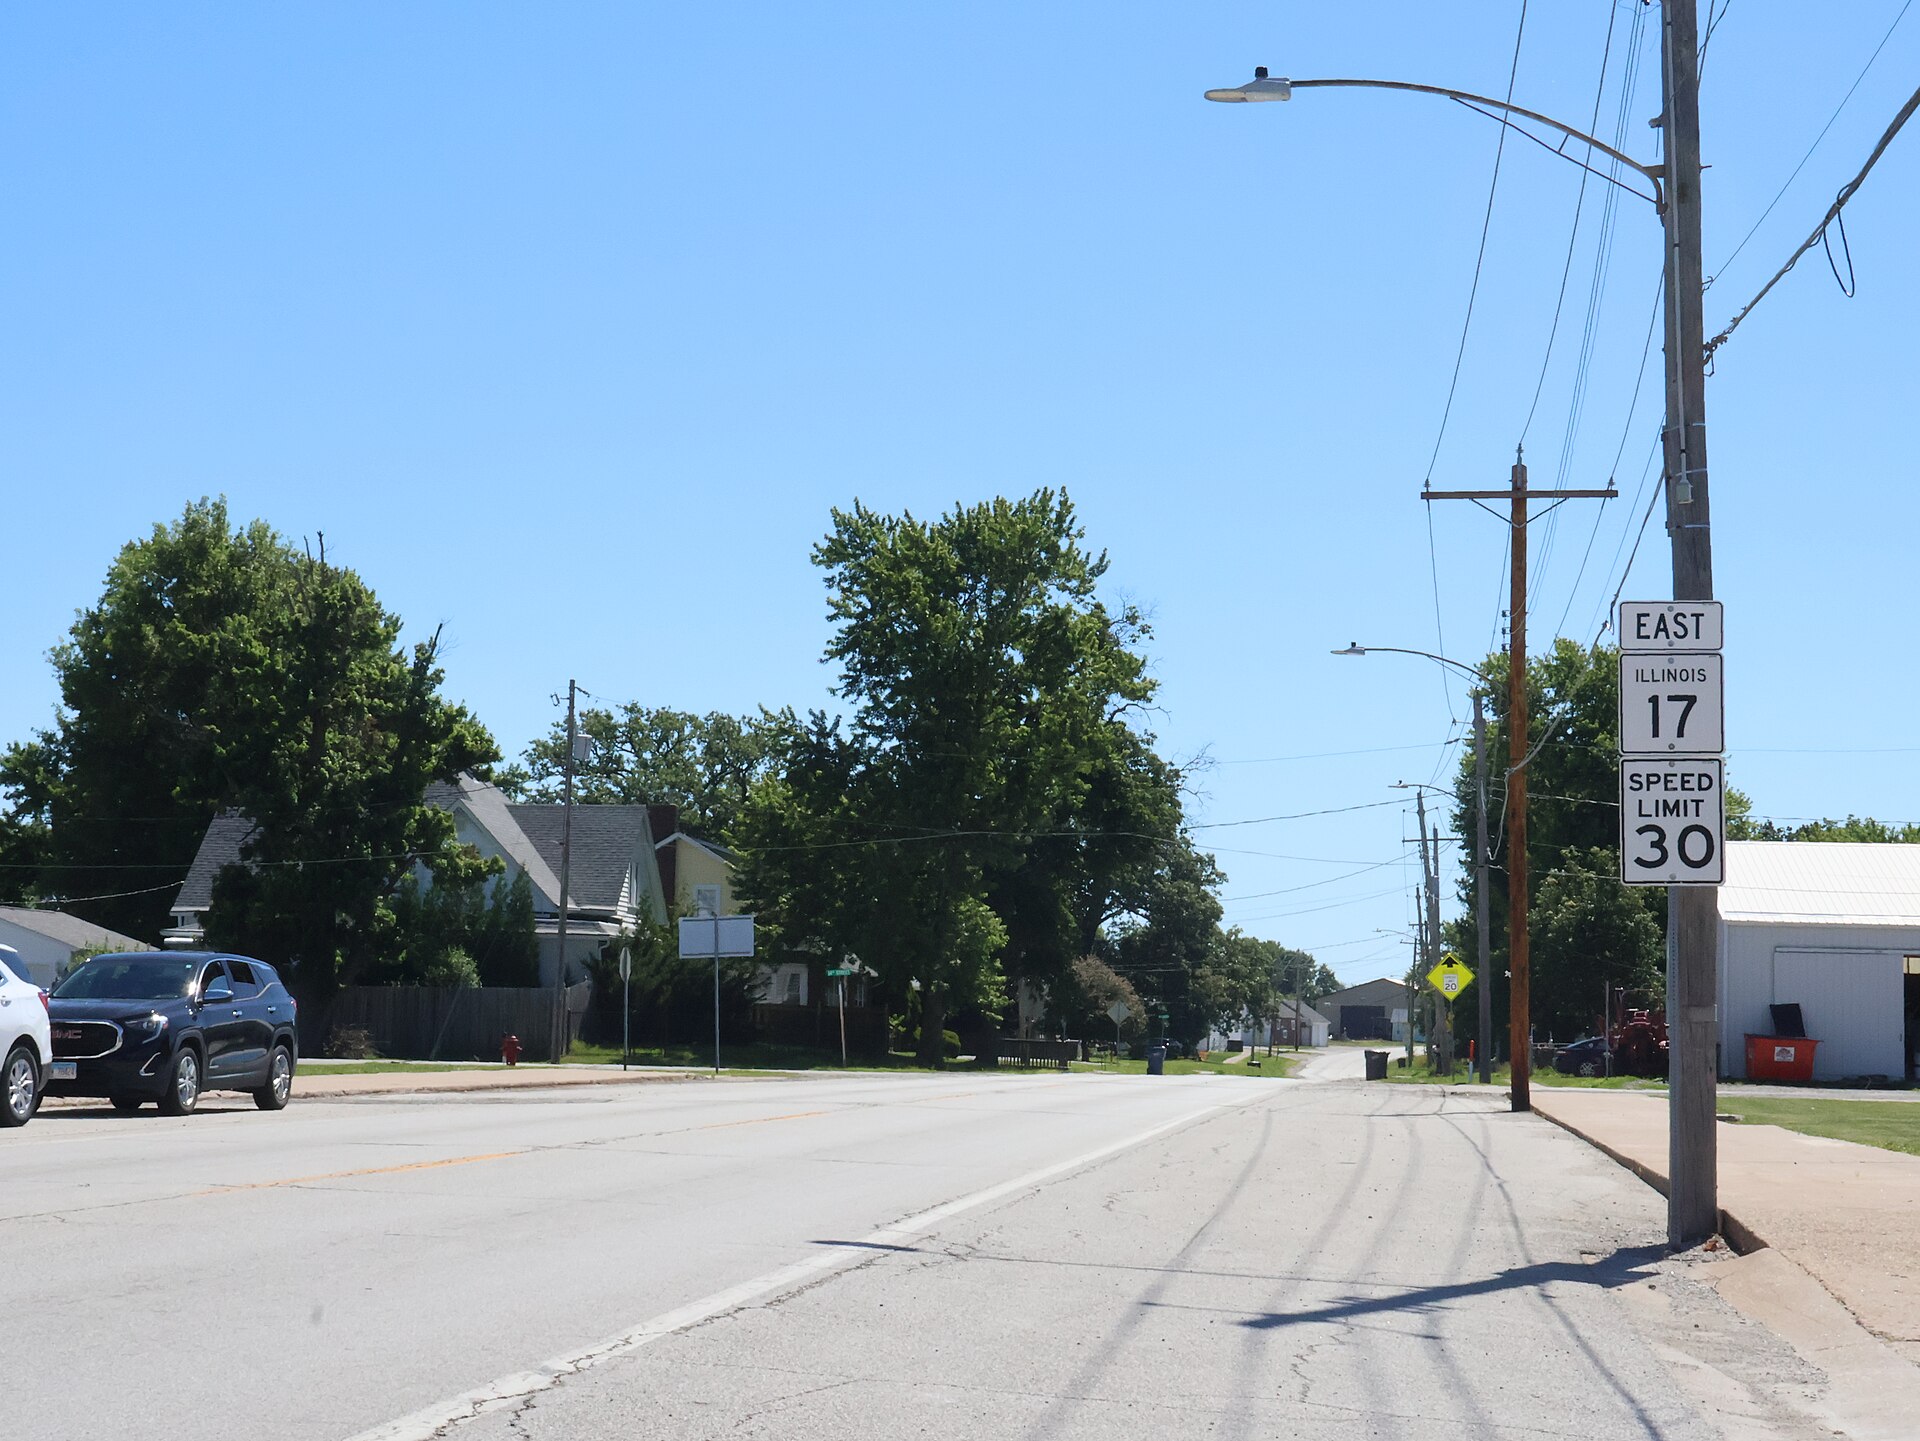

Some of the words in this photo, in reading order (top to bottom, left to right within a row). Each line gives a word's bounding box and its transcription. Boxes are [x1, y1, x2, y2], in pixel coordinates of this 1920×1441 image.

[1636, 613, 1704, 639] EAST
[1635, 668, 1707, 683] ILLINOIS
[1648, 694, 1698, 739] 17
[1629, 773, 1714, 792] SPEED
[1637, 799, 1705, 818] LIMIT
[1634, 824, 1714, 869] 30
